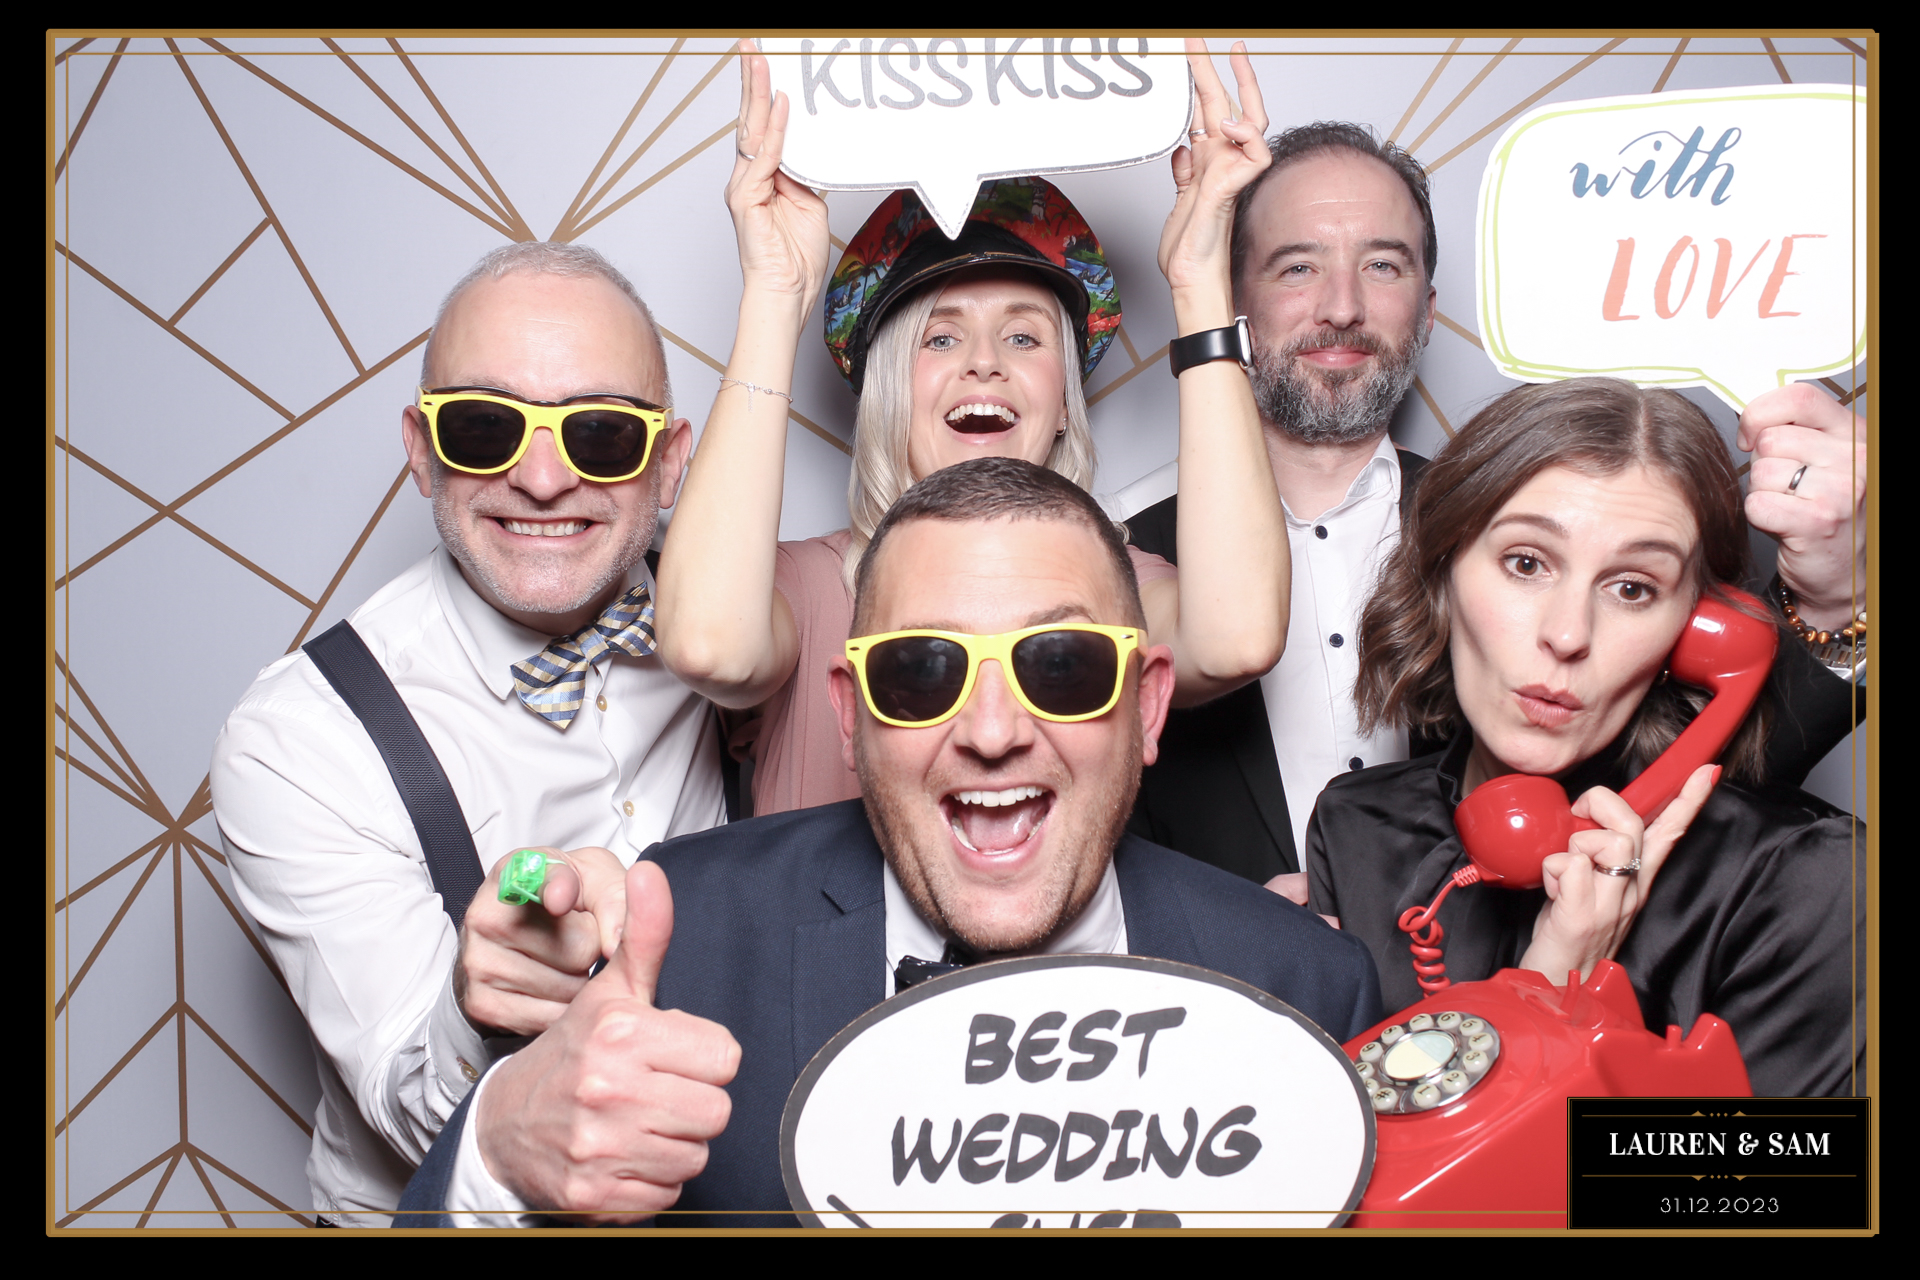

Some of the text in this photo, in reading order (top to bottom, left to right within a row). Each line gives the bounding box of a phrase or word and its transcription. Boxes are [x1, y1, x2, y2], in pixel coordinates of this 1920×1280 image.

[801, 38, 1154, 115] KISS KISS
[1569, 126, 1742, 206] with
[1602, 234, 1828, 322] LOVE
[965, 1006, 1187, 1085] BEST
[891, 1105, 1262, 1186] WEDDING
